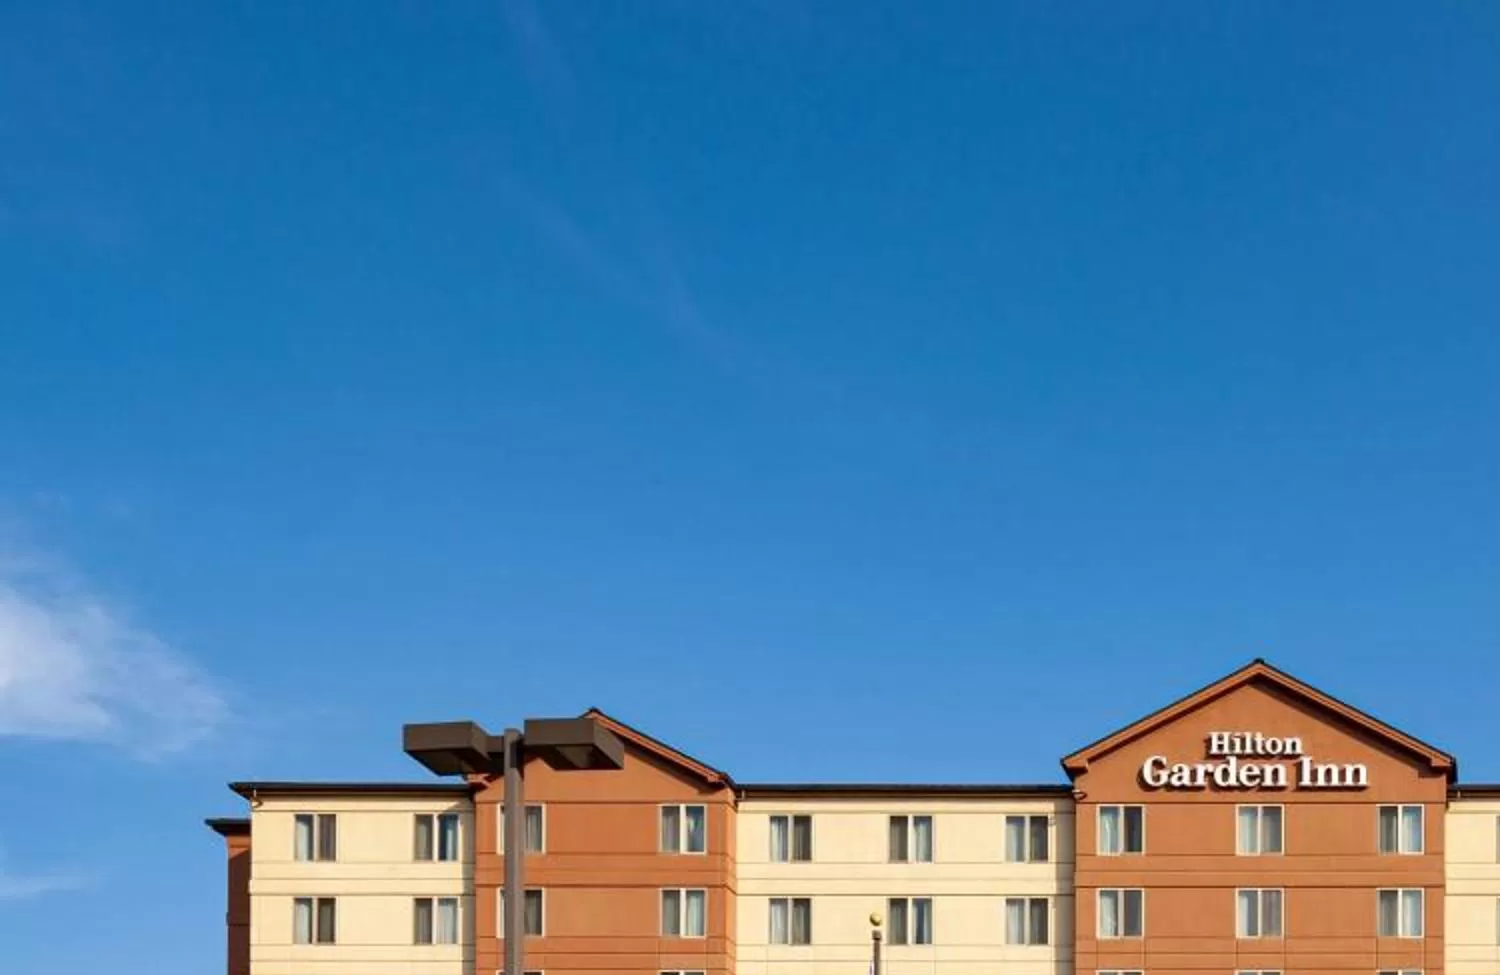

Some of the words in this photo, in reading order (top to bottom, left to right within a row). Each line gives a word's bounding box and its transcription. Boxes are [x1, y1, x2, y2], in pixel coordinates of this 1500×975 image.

[1209, 731, 1303, 755] Hilton
[1143, 755, 1288, 787] Garden
[1299, 755, 1368, 787] Inn
